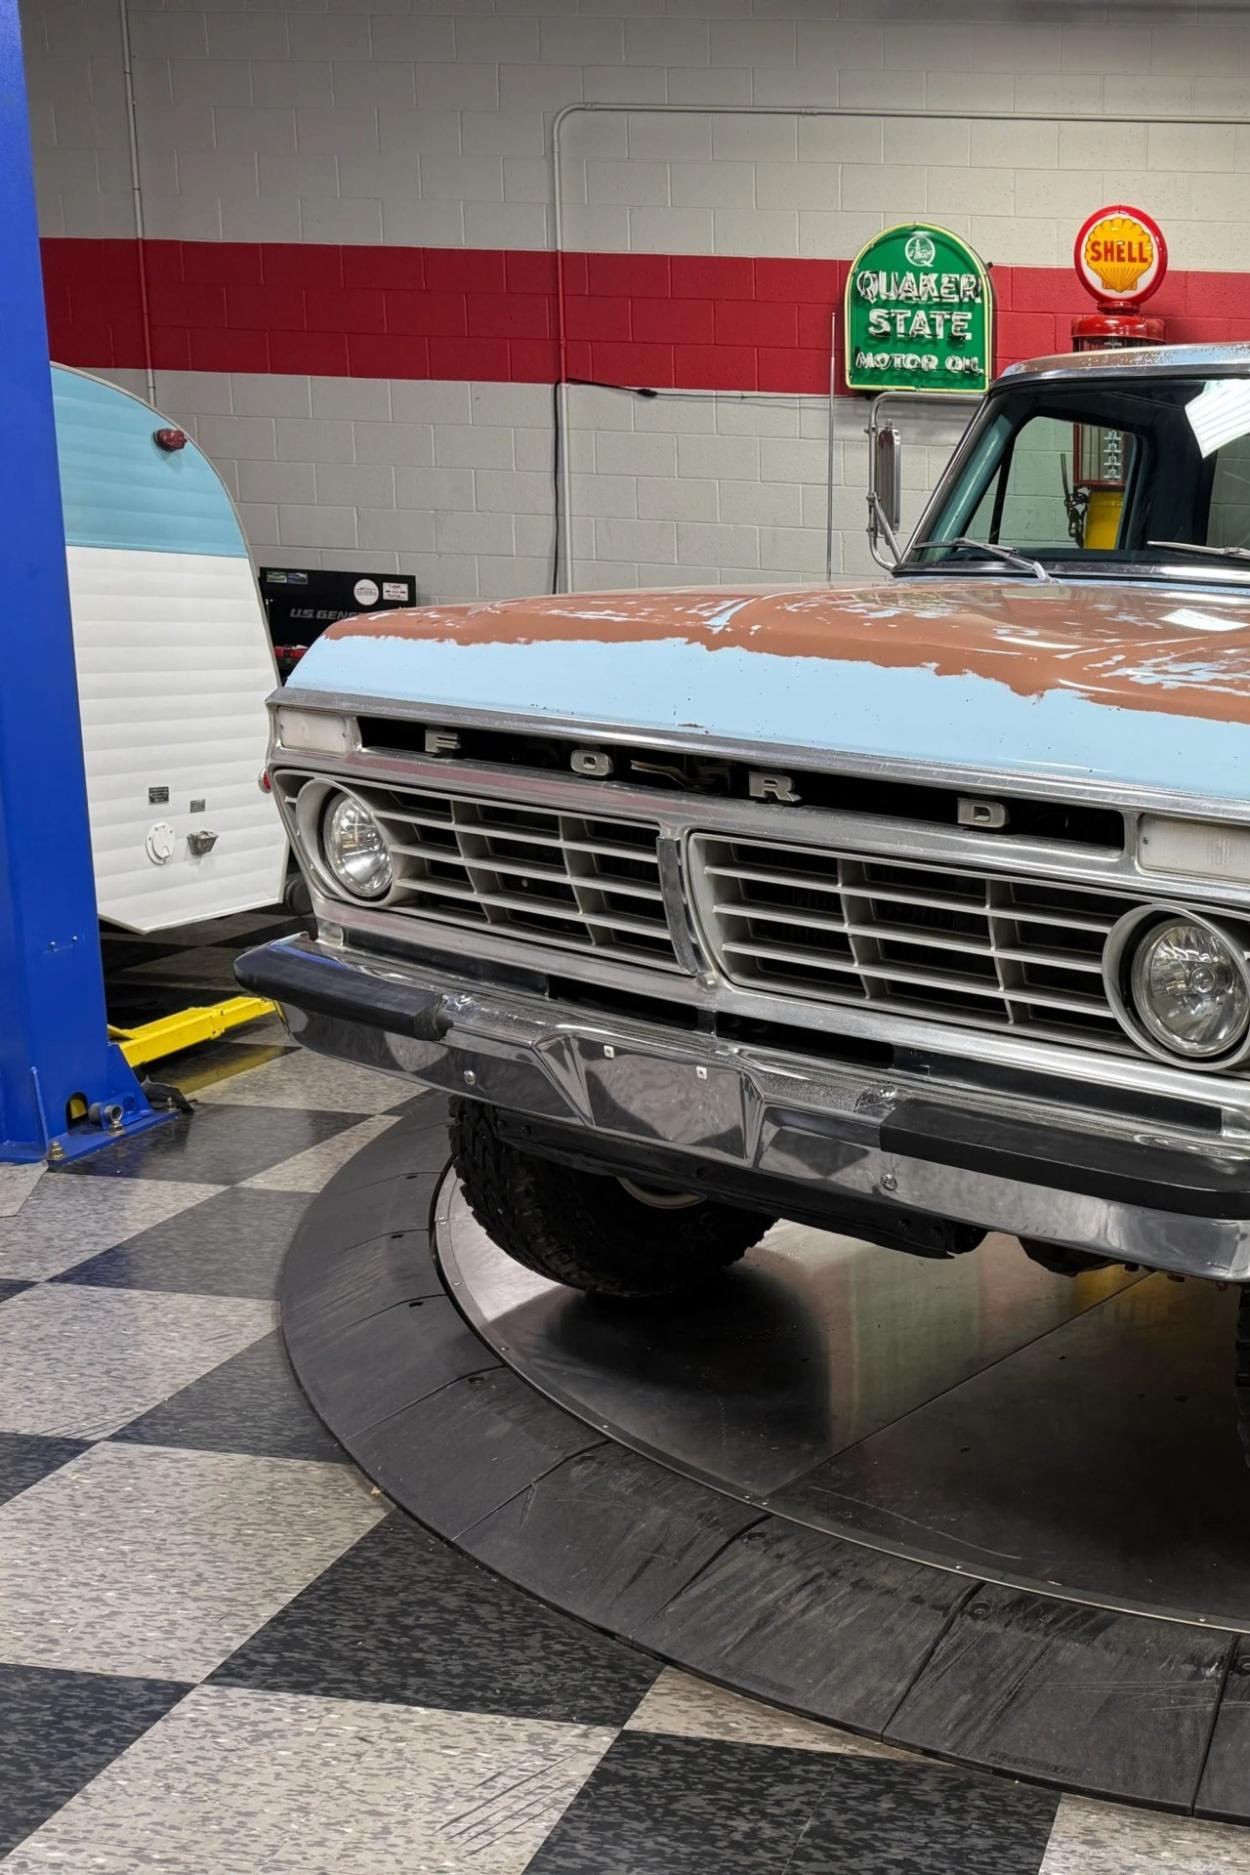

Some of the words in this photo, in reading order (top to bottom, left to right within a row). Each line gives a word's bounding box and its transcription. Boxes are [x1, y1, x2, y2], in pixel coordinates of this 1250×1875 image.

[1090, 240, 1149, 263] SHELL
[857, 270, 982, 304] QUAKER
[868, 308, 972, 340] STATE
[856, 352, 939, 371] MOTOR
[945, 355, 984, 374] OIL
[424, 729, 1010, 828] FORD
